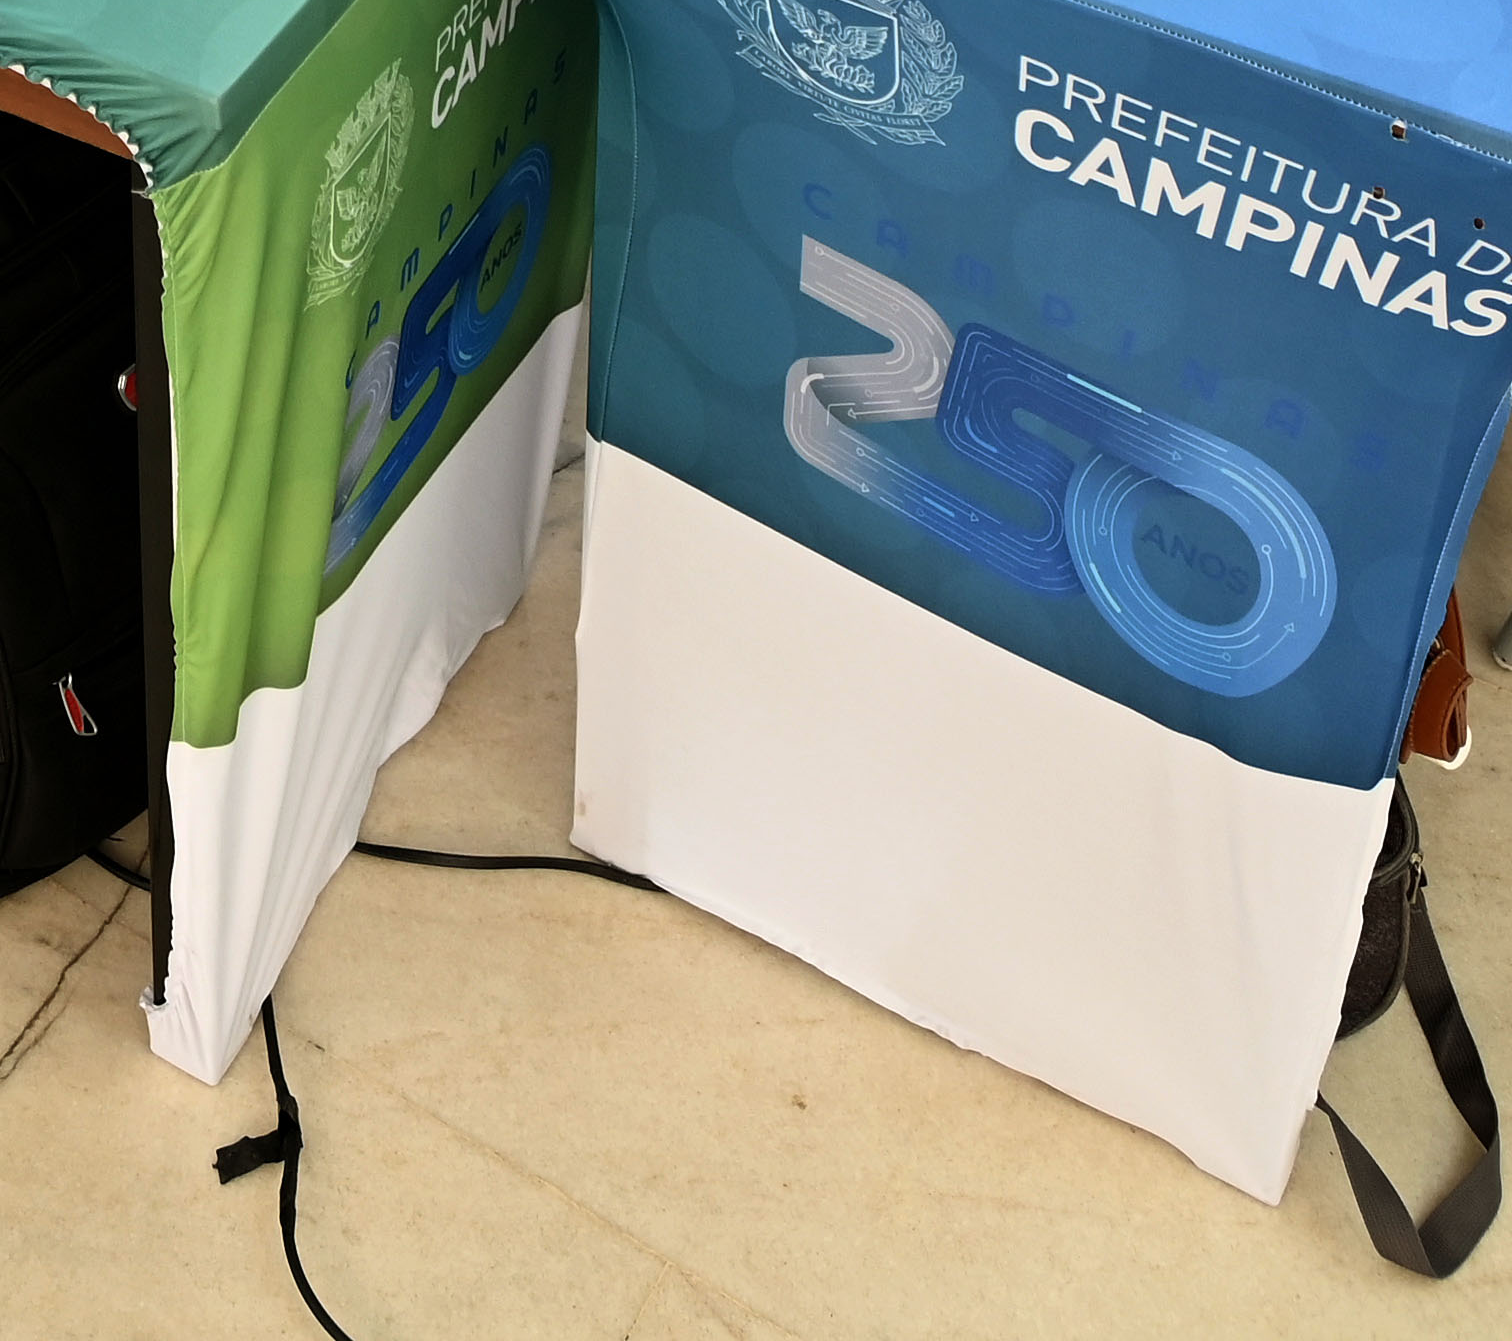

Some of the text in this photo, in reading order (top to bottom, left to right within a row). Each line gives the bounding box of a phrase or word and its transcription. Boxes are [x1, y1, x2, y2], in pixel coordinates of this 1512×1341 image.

[479, 220, 524, 294] ANOS
[1018, 55, 1438, 259] PREFEITURA
[802, 181, 1393, 476] CAMPINAS
[783, 233, 1338, 699] 250
[1140, 522, 1252, 597] ANOS
